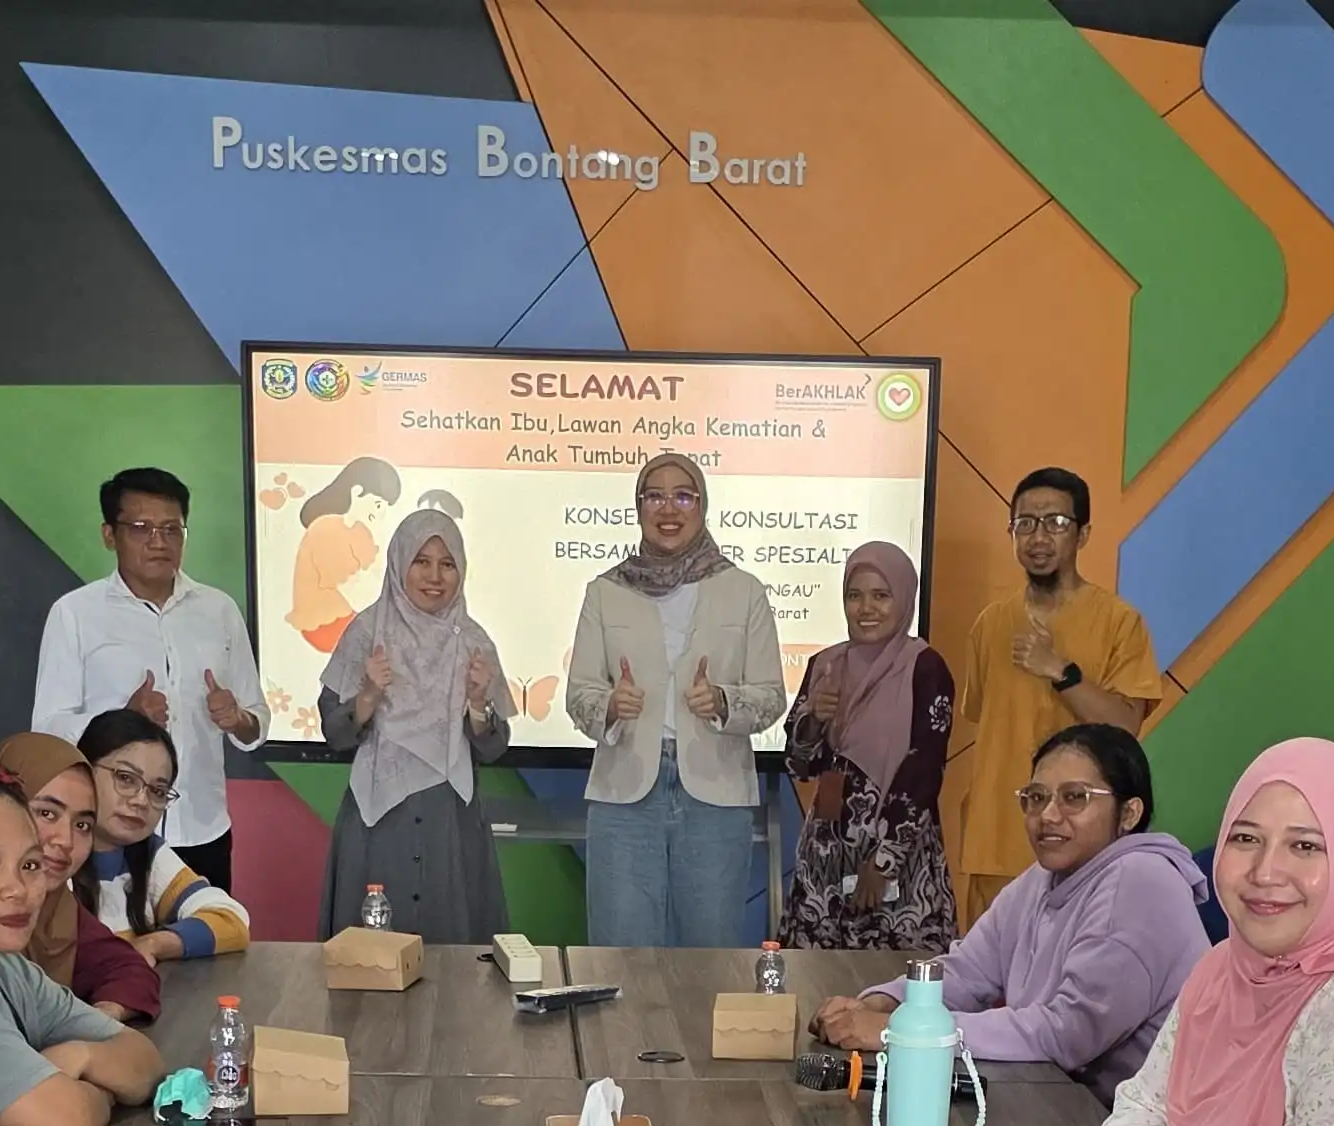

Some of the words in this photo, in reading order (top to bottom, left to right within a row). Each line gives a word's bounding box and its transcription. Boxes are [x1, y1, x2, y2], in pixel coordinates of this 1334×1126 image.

[212, 116, 448, 176] Puskesmas
[477, 125, 660, 190] Bontang
[689, 131, 807, 187] Barat
[382, 372, 427, 383] GERMAS
[510, 372, 685, 401] SELAMAT
[776, 383, 866, 400] BerAKHLAK
[400, 410, 501, 432] Sehatkan
[632, 416, 696, 440] Angka
[705, 417, 802, 438] Kematian
[812, 420, 827, 438] &
[506, 444, 558, 464] Anak
[567, 445, 648, 466] Tumbuh
[659, 447, 722, 467] Tpat
[565, 507, 640, 525] KONSE
[719, 510, 858, 530] KONSULTASI
[555, 541, 639, 560] BERSAM
[754, 546, 852, 564] SPESIALI
